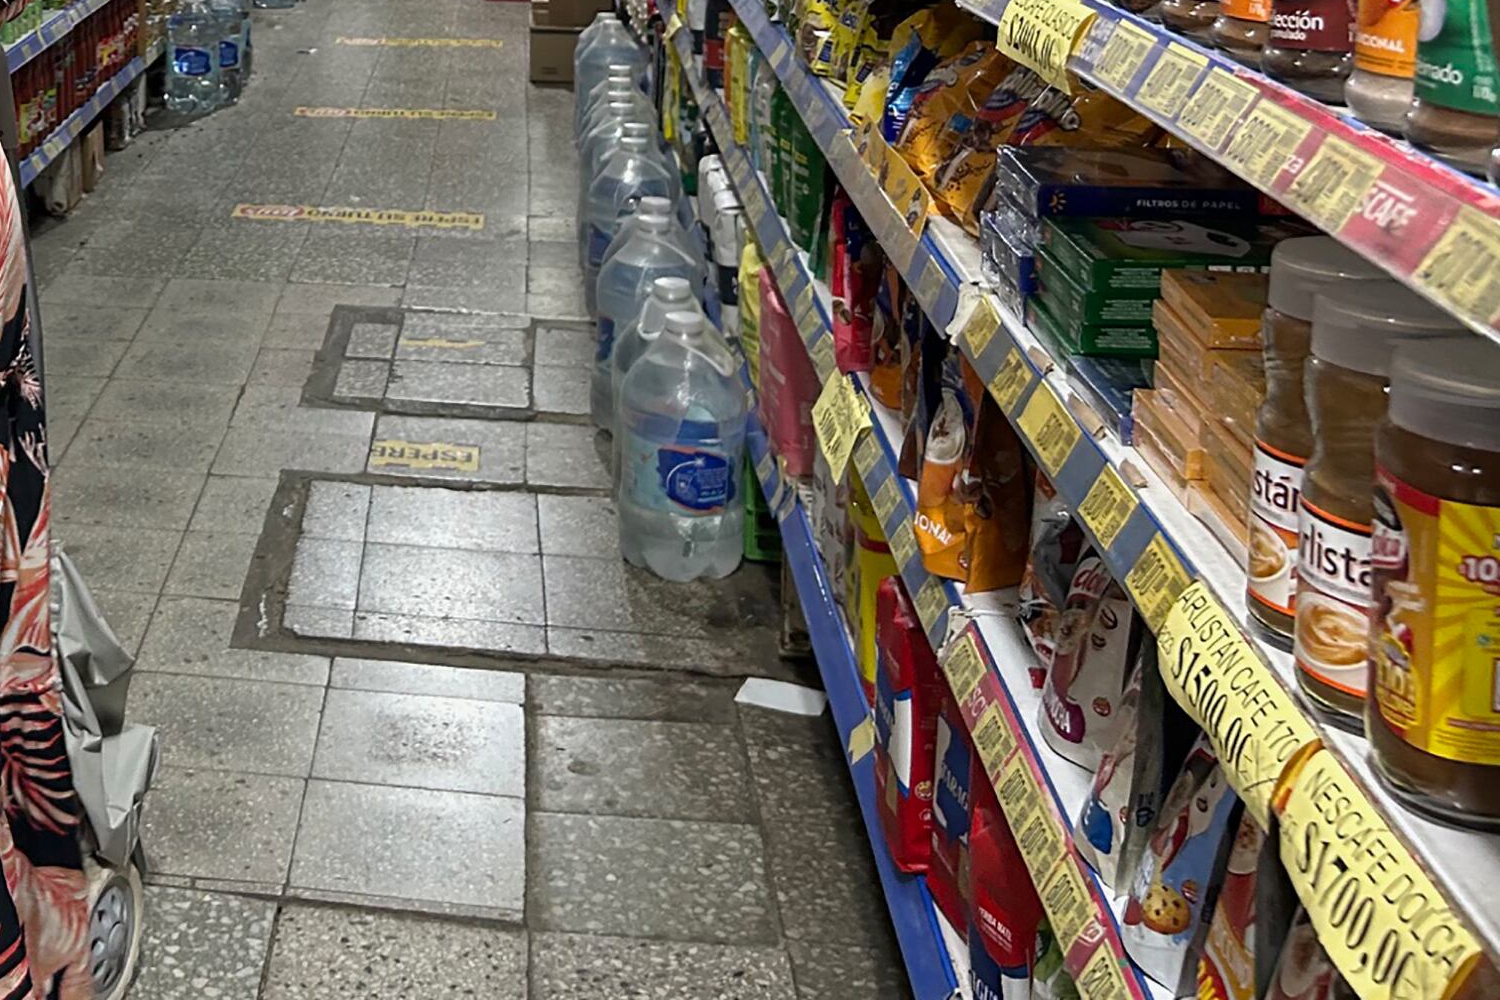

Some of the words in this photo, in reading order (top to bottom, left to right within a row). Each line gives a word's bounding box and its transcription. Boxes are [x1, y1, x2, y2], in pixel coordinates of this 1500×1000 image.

[1272, 9, 1324, 32] ección
[1136, 199, 1178, 210] FILTROS
[1181, 200, 1198, 210] DE
[1202, 200, 1240, 210] PAPEL
[370, 444, 474, 463] ESPERE
[1230, 666, 1279, 729] CAFE
[1303, 767, 1400, 886] NESCAFE
[1382, 873, 1467, 969] DOLCA
